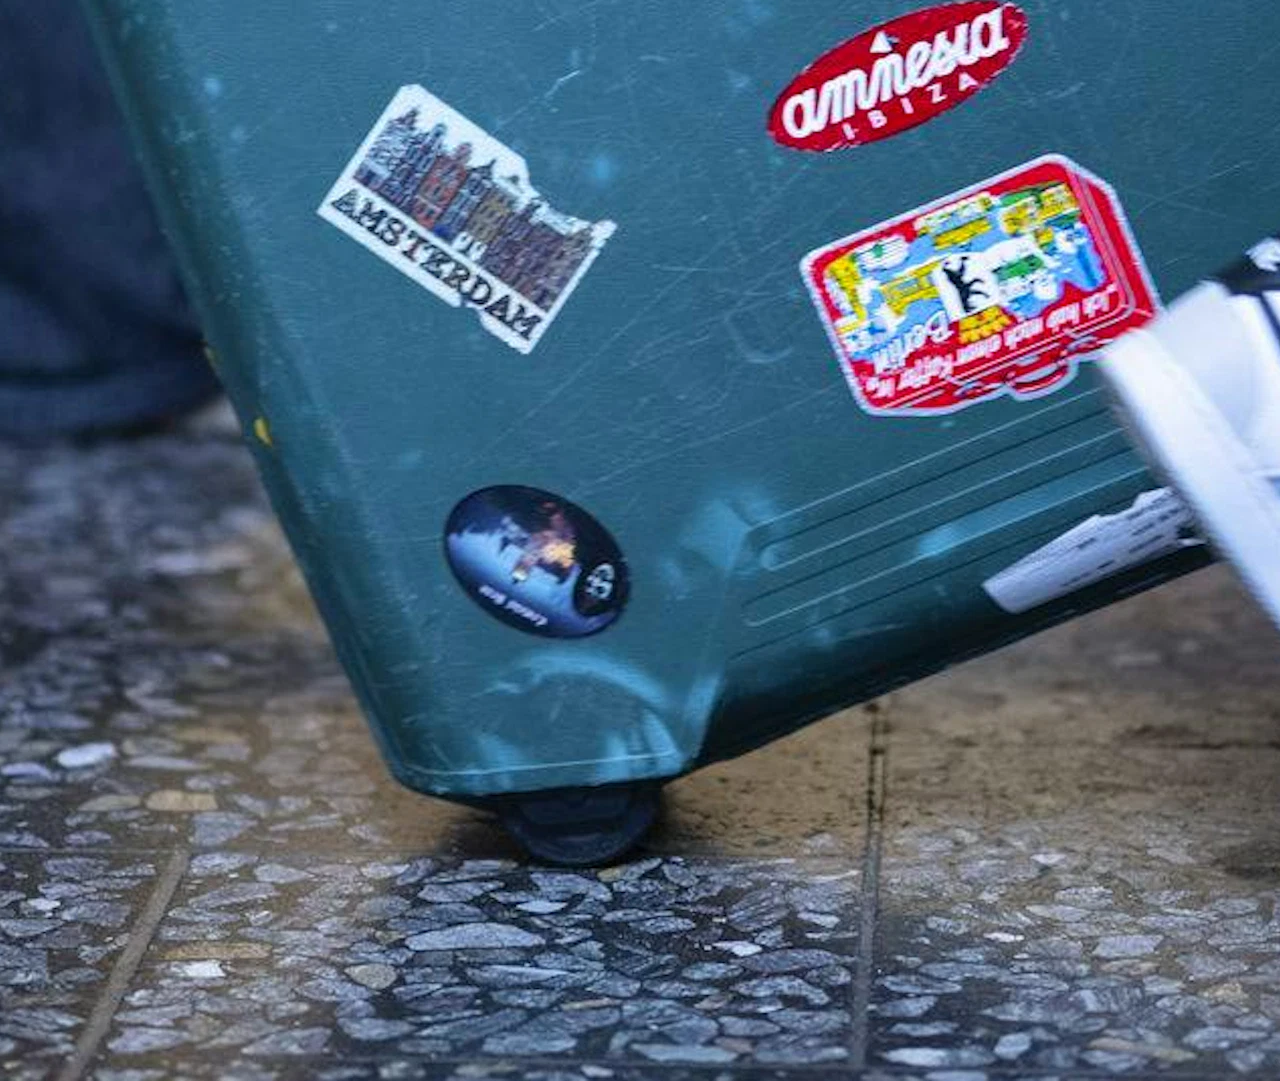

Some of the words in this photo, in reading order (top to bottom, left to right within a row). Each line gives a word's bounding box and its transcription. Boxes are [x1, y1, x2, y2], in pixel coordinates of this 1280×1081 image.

[782, 7, 1011, 139] amnesia
[842, 72, 978, 141] IBIZA
[331, 188, 544, 341] AMSTERDAM
[872, 309, 956, 374] Berlin
